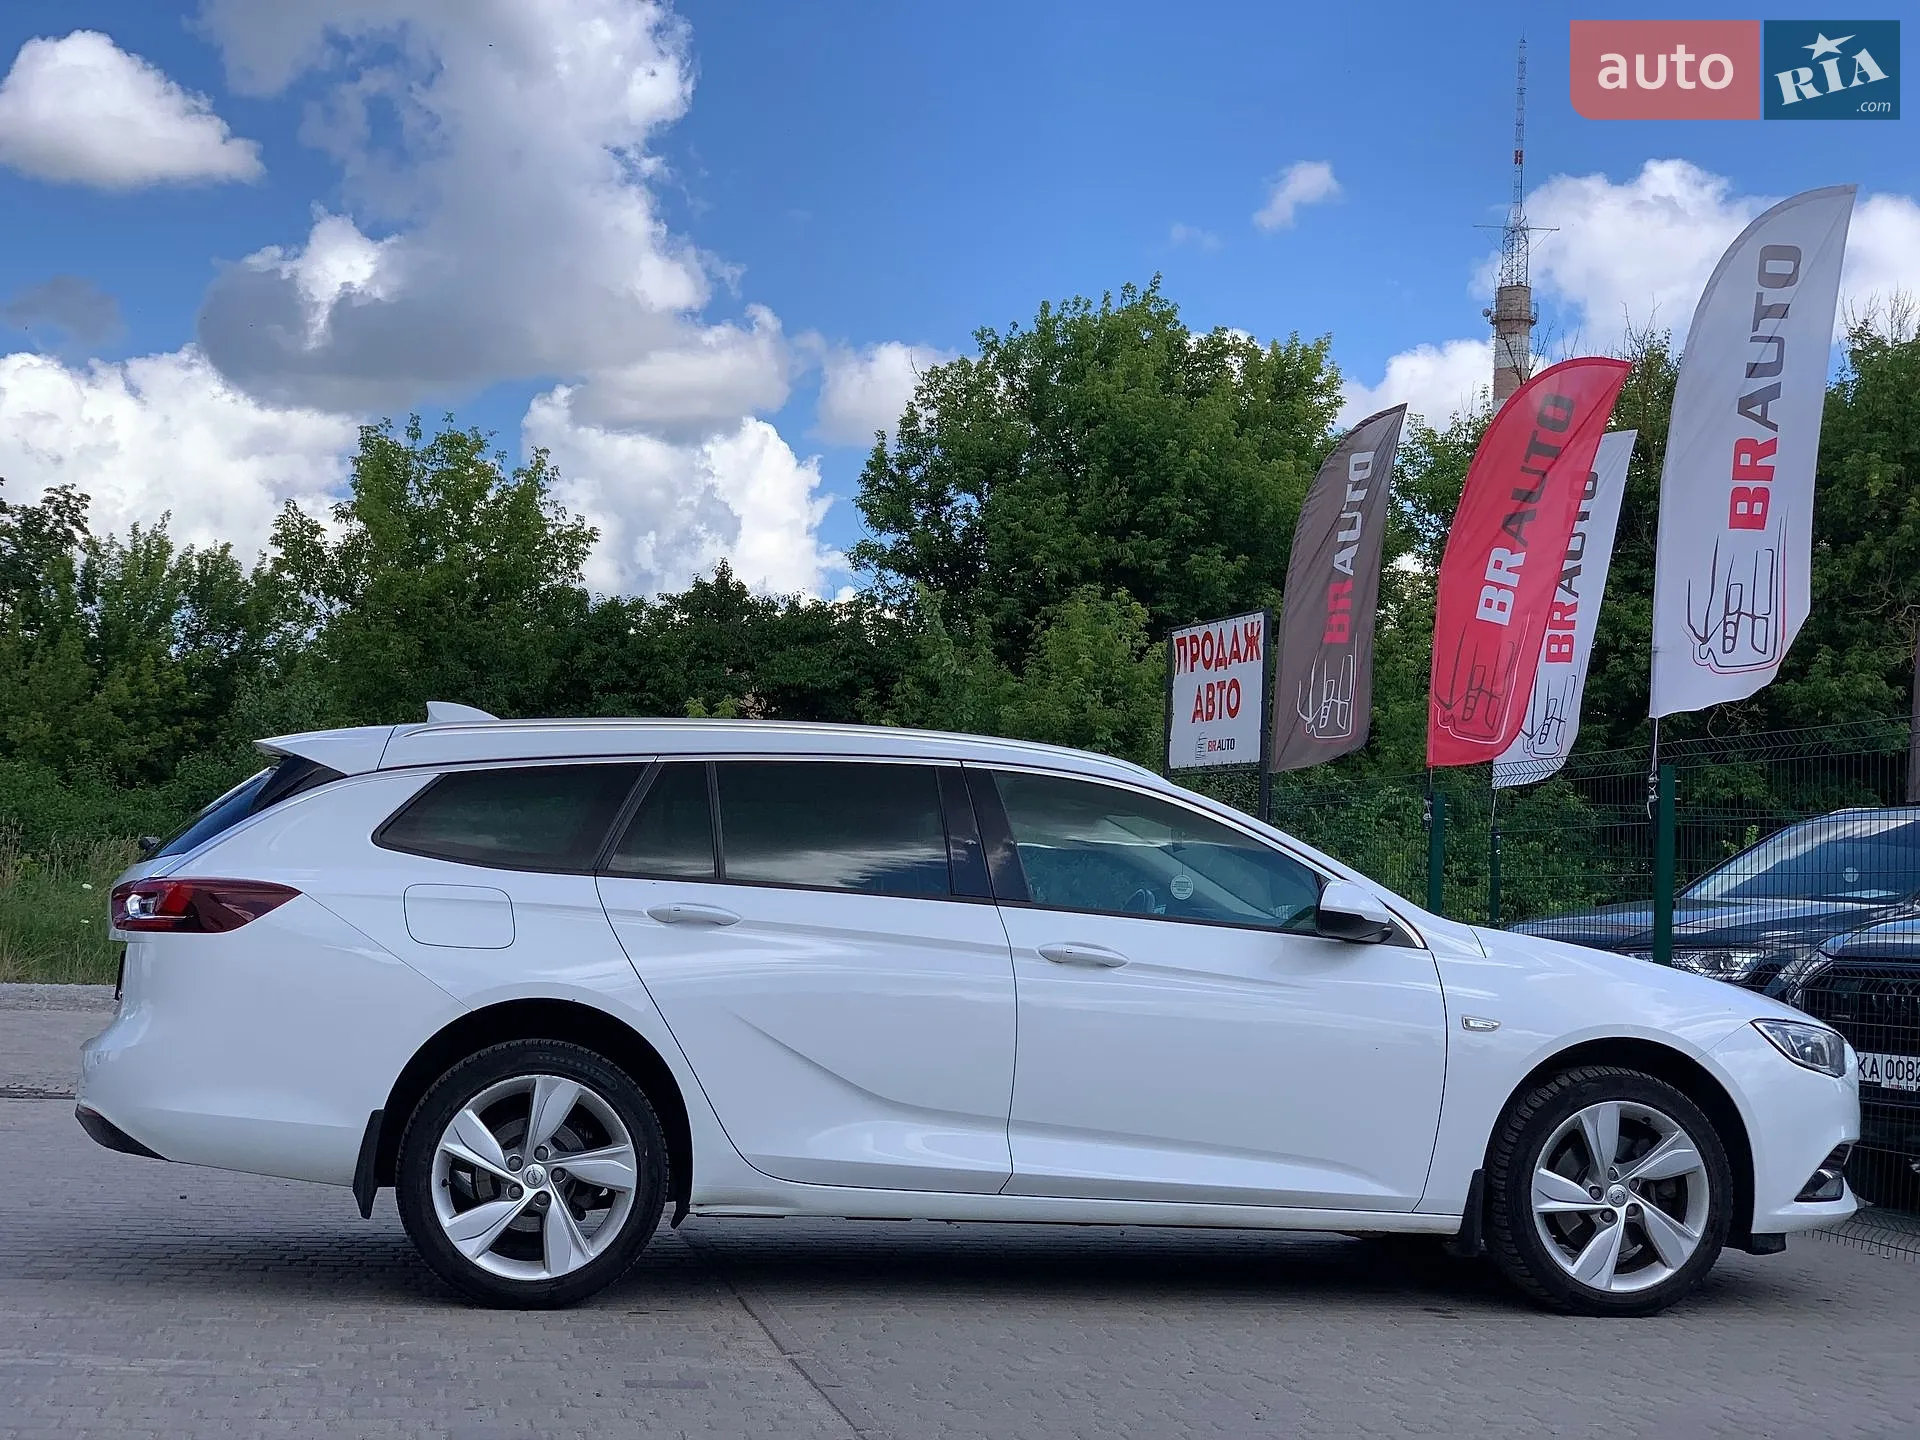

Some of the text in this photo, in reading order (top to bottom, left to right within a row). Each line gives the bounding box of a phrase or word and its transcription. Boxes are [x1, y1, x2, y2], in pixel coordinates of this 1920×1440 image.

[1728, 243, 1802, 531] BRAUTO
[1175, 620, 1262, 675] ПРОДАЖ
[1191, 677, 1241, 724] АВТО
[1207, 738, 1236, 753] BRAUTO
